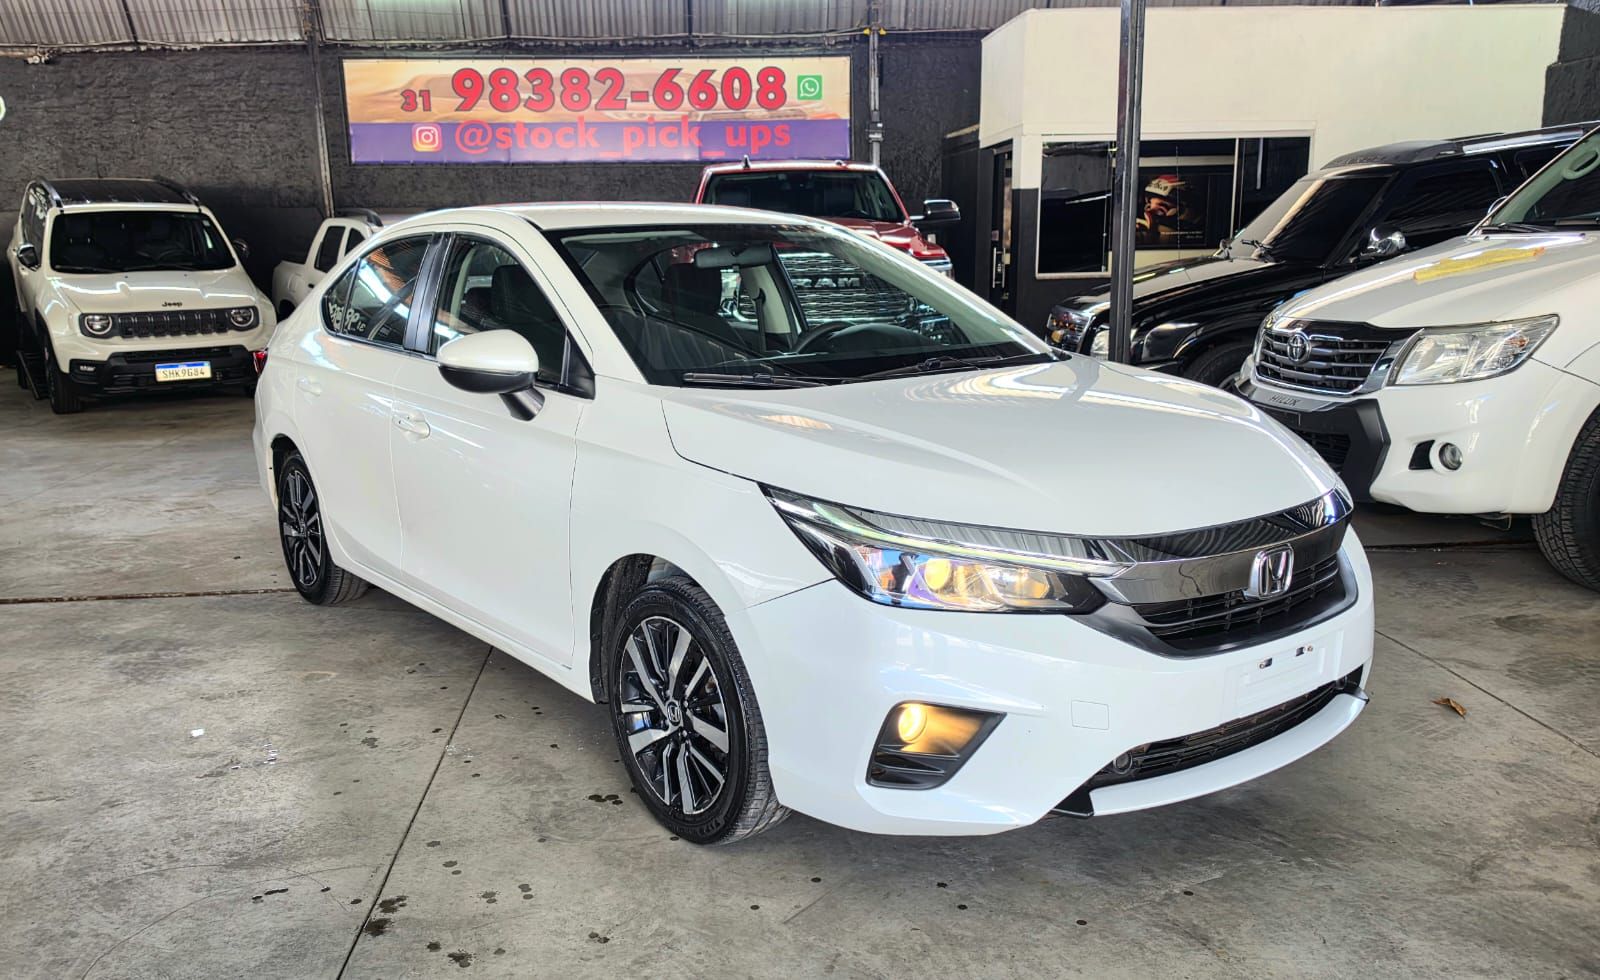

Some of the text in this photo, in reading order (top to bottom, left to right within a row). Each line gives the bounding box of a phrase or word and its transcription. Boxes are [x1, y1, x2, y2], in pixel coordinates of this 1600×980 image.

[400, 66, 788, 113] 31 98382-6608
[454, 114, 792, 158] @stock_pick_ups
